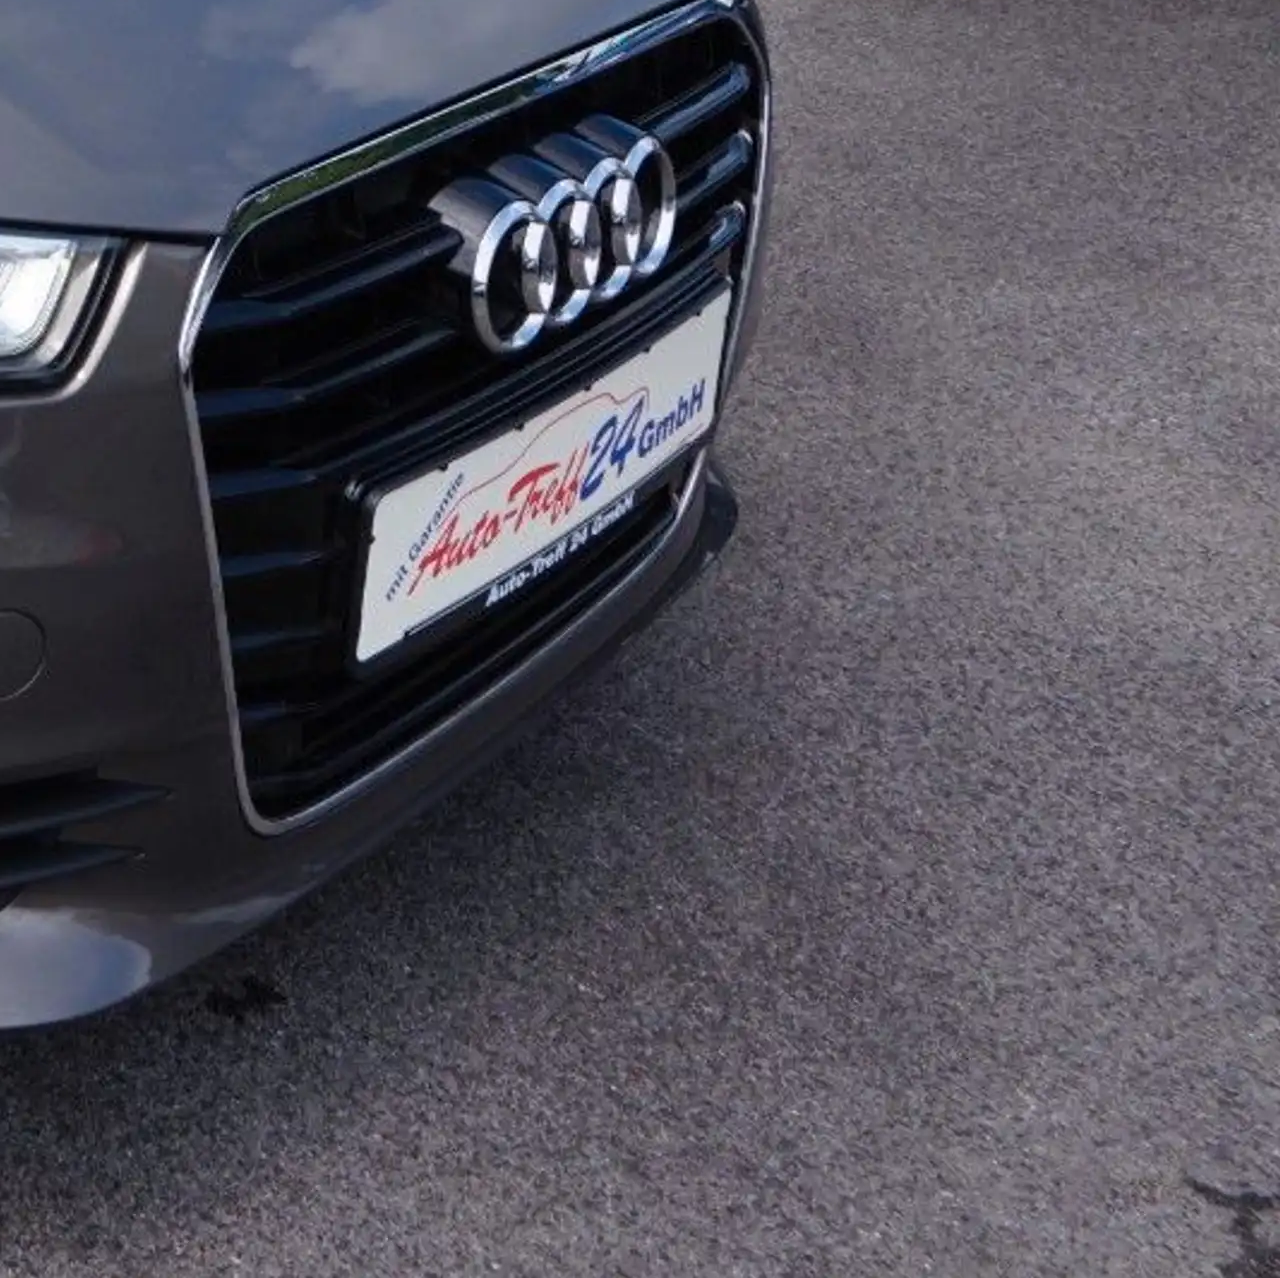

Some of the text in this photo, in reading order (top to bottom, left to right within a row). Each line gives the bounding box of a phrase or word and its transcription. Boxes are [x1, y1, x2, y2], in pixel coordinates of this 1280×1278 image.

[407, 378, 706, 596] Auto-Treff 24 GmbH
[408, 472, 466, 562] Garantie
